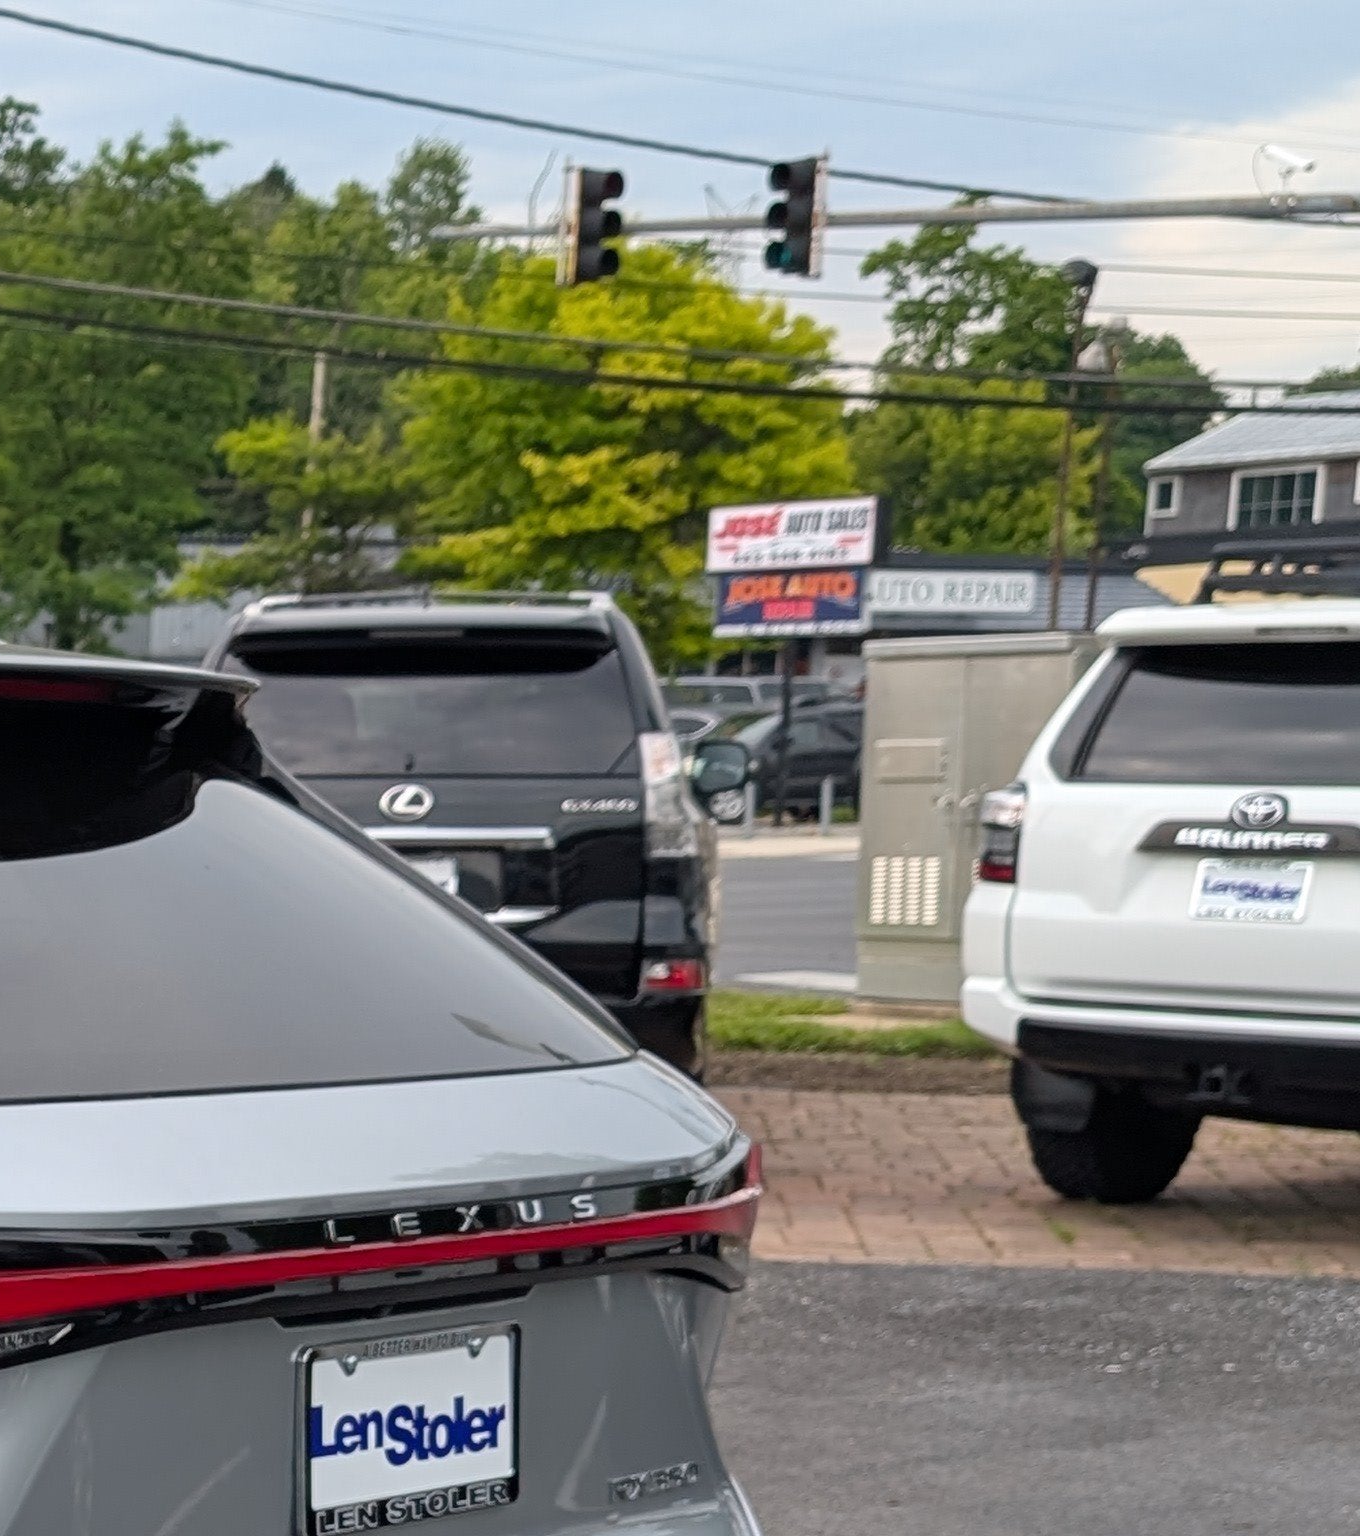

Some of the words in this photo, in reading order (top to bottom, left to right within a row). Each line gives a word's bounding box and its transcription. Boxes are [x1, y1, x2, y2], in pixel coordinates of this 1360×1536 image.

[865, 578, 933, 602] UTO
[942, 580, 1028, 603] REPAIR
[324, 1194, 597, 1242] LEXUS
[385, 1480, 511, 1524] STOLER
